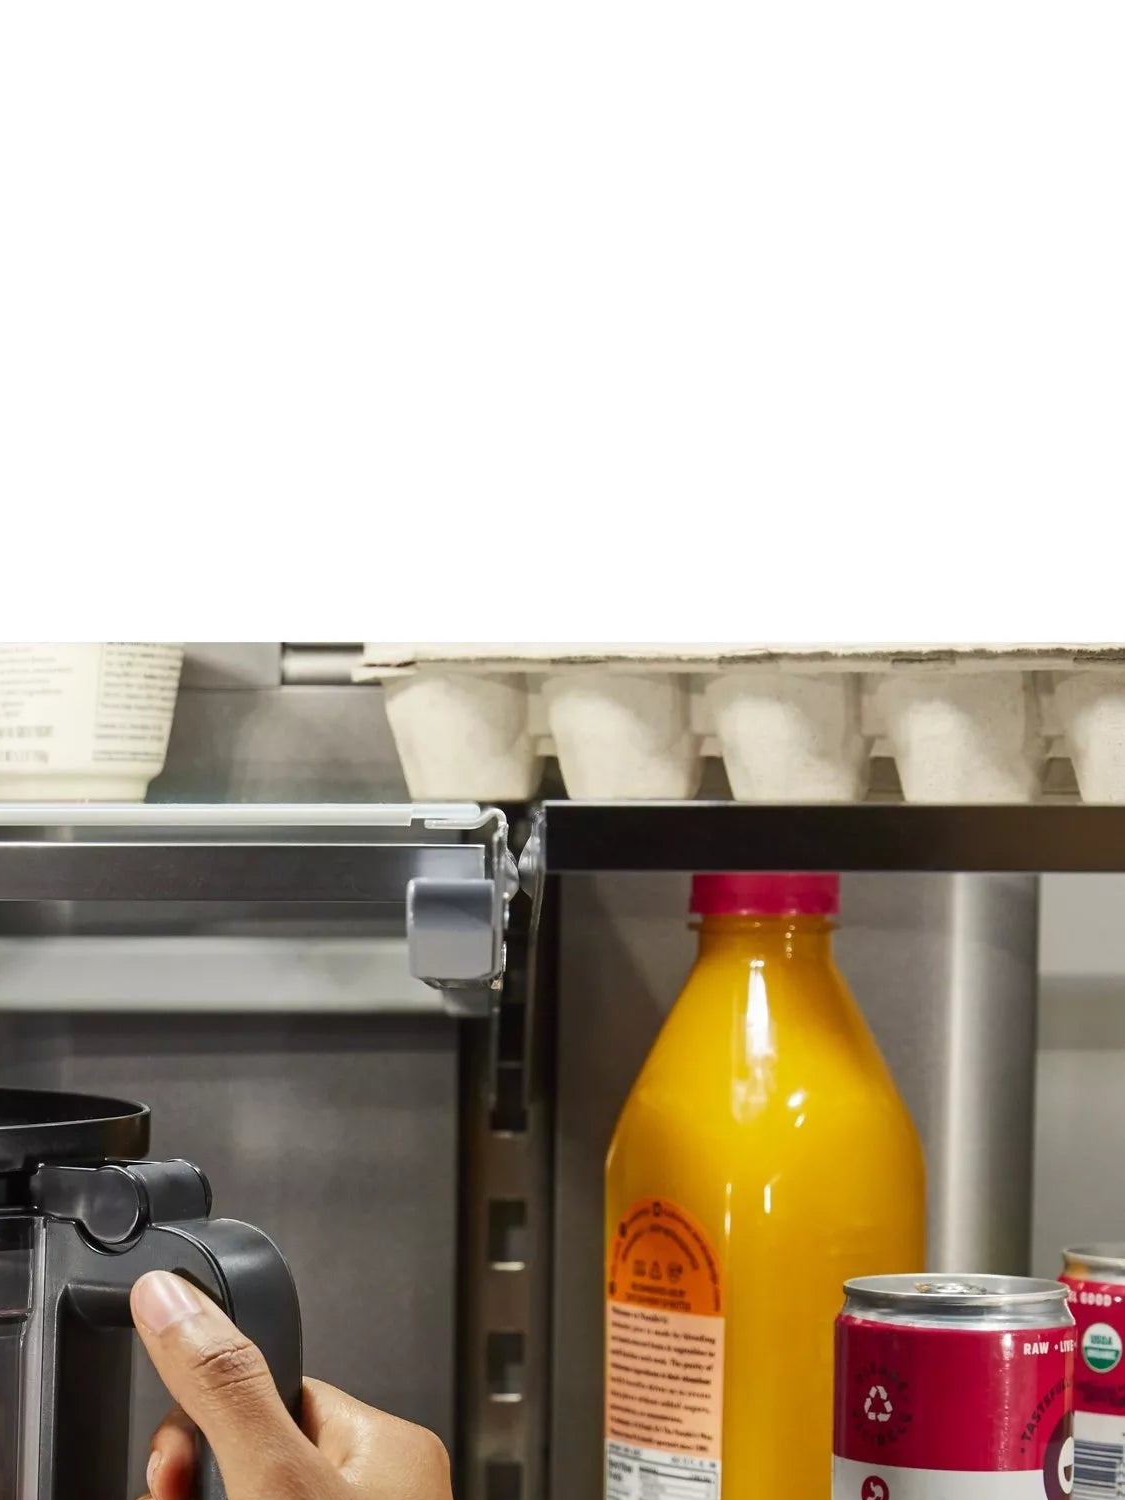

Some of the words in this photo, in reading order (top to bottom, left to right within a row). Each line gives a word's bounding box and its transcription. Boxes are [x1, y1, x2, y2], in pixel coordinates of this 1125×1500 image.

[1080, 1291, 1112, 1307] GOOD
[1023, 1341, 1050, 1355] RAW
[1059, 1339, 1074, 1353] LIVE
